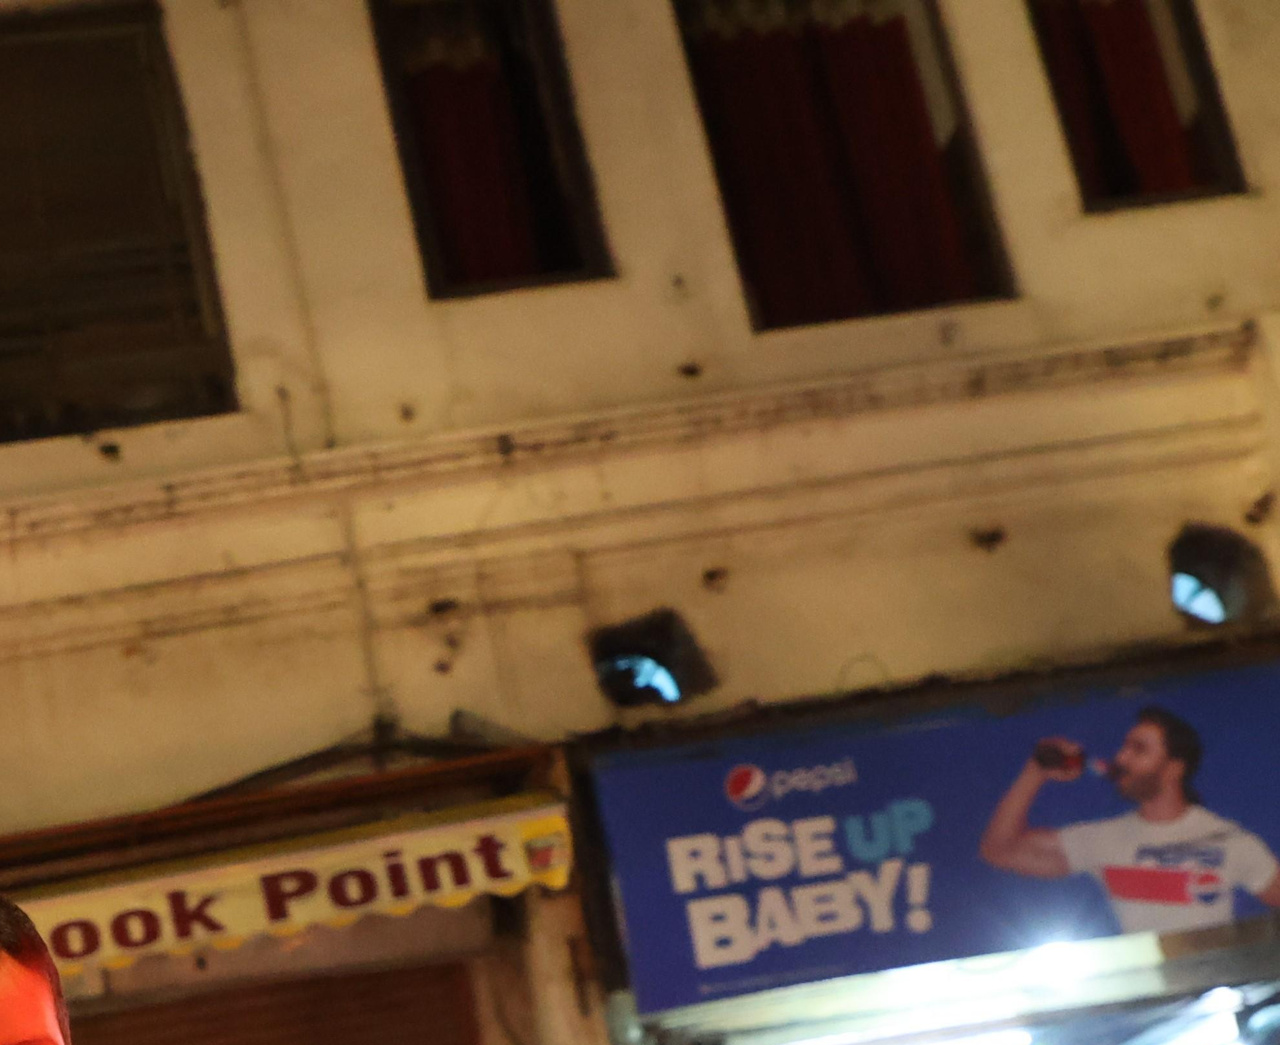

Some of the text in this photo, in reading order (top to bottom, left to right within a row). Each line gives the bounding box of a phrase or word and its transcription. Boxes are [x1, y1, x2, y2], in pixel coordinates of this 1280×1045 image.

[771, 757, 858, 799] pepsi
[844, 798, 934, 861] UP
[49, 834, 513, 959] ook Point
[686, 858, 933, 970] BABY!
